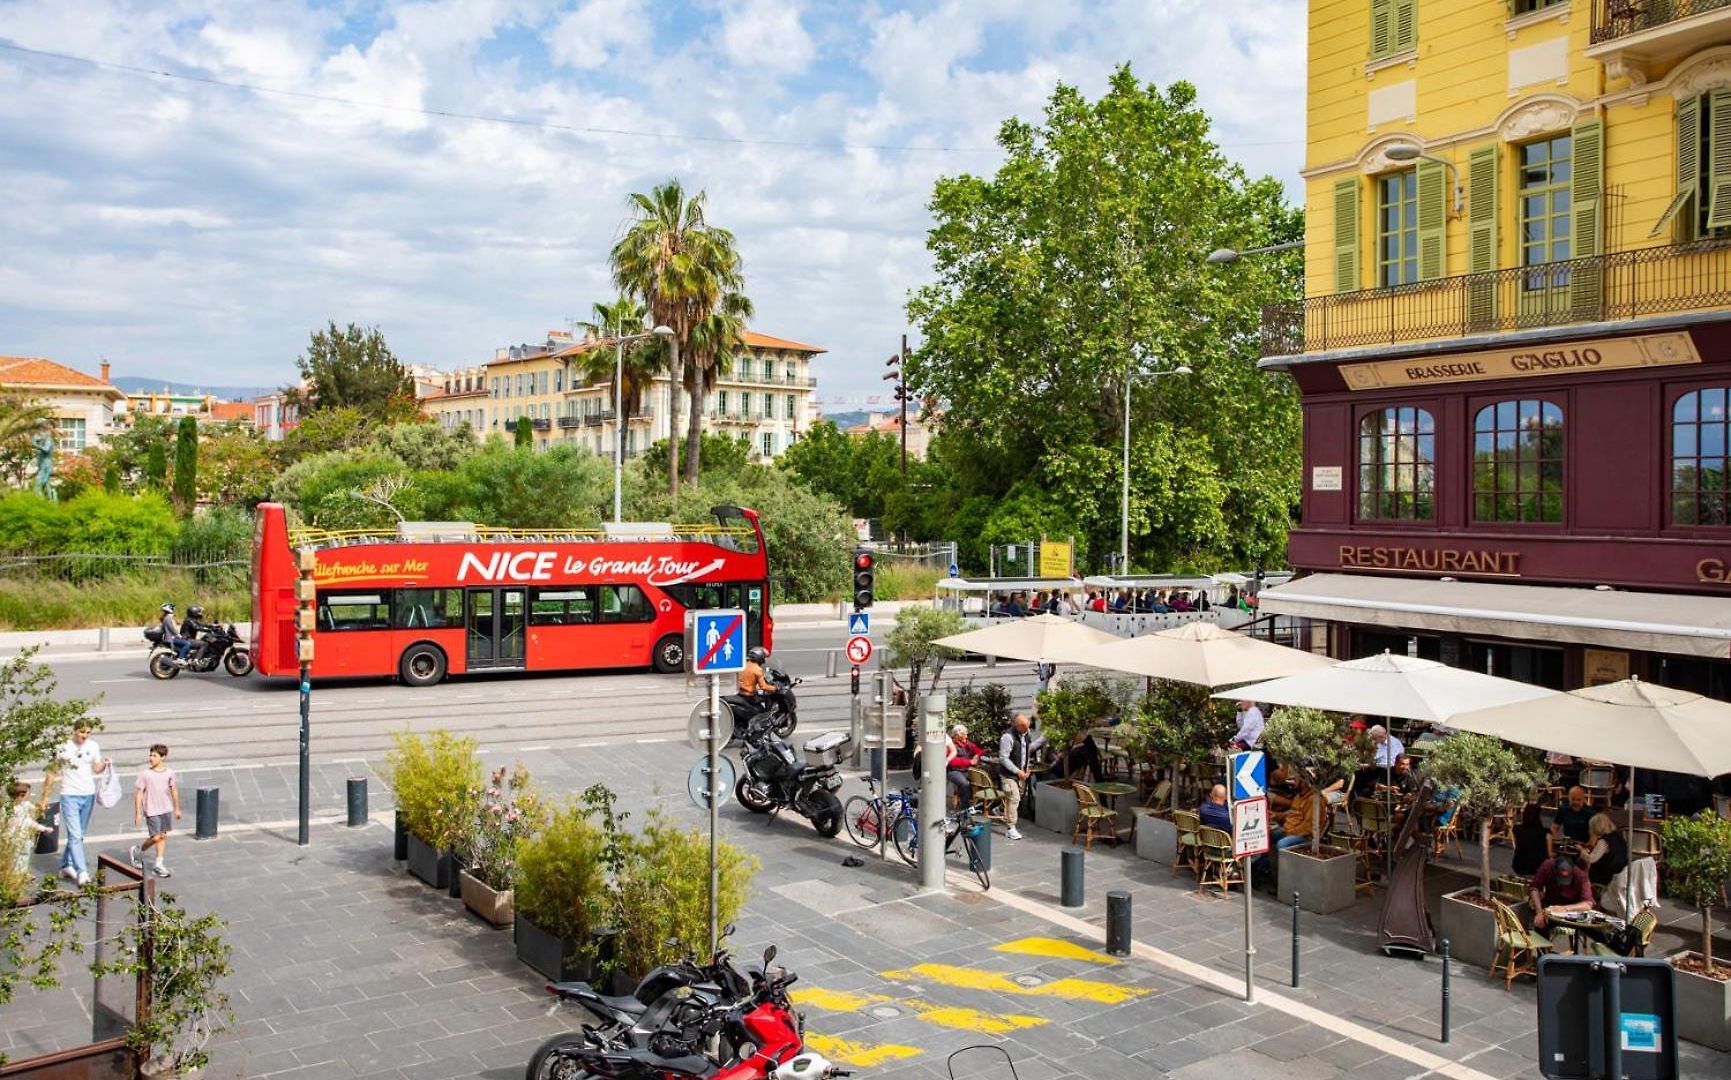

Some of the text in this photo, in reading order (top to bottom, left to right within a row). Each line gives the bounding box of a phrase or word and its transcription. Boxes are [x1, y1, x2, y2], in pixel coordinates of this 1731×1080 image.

[1406, 348, 1602, 380] BRASSERIE GAGLIO
[380, 563, 401, 575] sur
[403, 559, 430, 573] Mer
[456, 551, 559, 582] NICE
[588, 556, 655, 576] Grand
[656, 556, 700, 575] Tour
[1339, 545, 1521, 573] RESTAURANT
[1696, 558, 1731, 583] G
